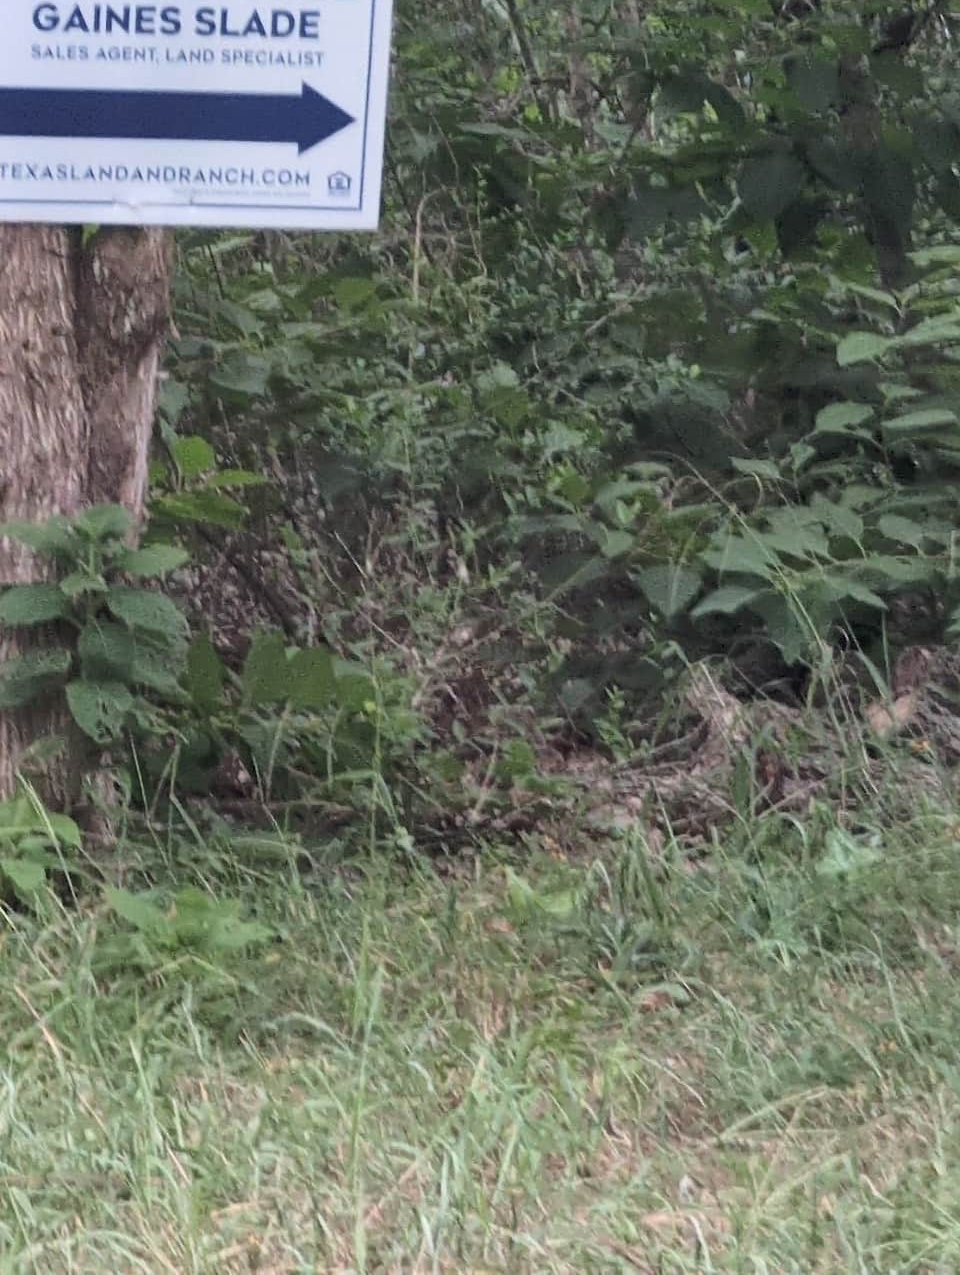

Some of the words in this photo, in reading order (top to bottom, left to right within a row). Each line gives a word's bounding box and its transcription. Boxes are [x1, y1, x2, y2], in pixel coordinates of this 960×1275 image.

[32, 3, 182, 36] GAINES
[194, 7, 321, 39] SLADE
[31, 45, 89, 61] SALES
[95, 47, 159, 65] AGENT,
[166, 48, 215, 64] LAND
[221, 50, 325, 67] SPECIALIST
